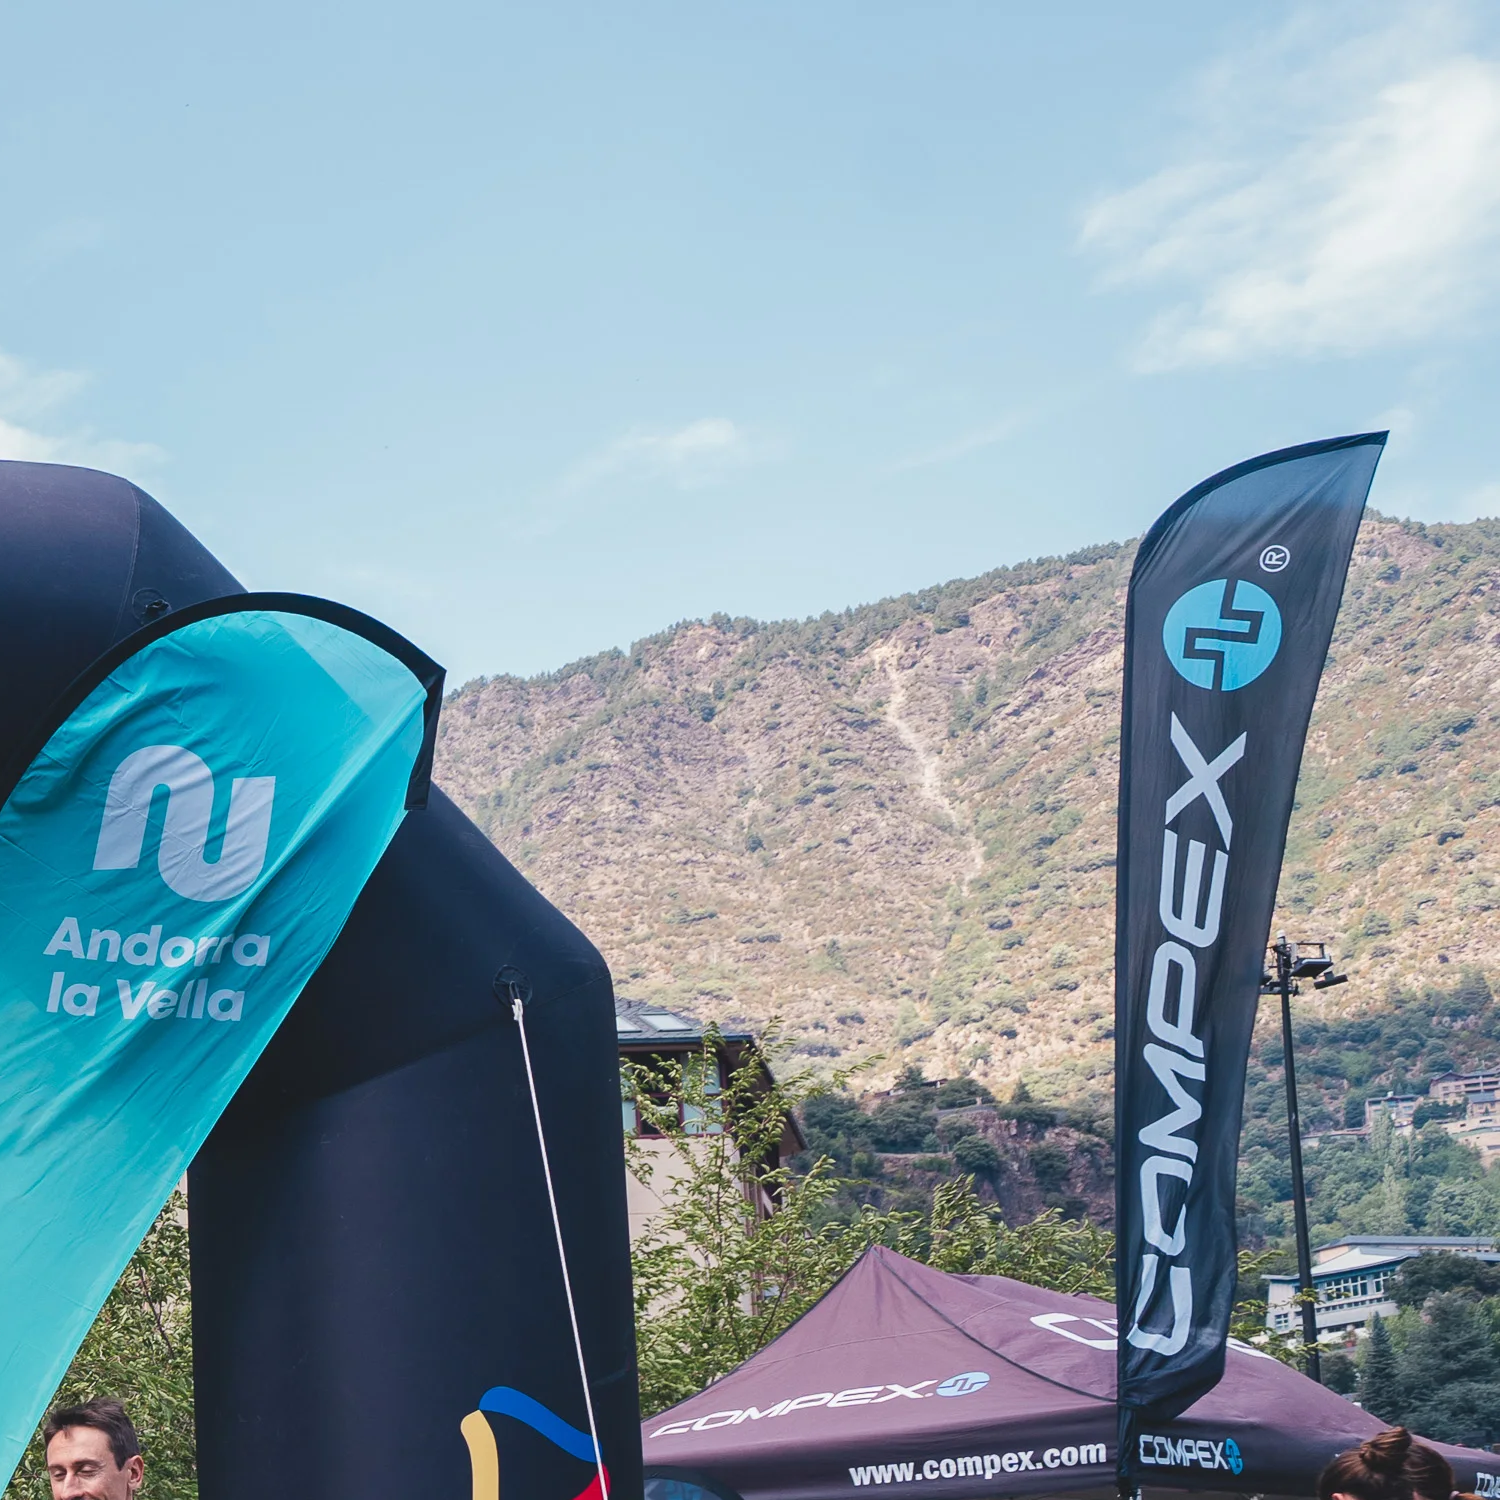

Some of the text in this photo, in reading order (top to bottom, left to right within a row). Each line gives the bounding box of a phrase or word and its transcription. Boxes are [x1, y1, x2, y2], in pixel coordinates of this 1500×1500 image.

[43, 917, 271, 969] Andorra
[46, 971, 245, 1022] la Vella
[1126, 711, 1247, 1357] COMPEX
[649, 1379, 939, 1439] COMPEX
[849, 1443, 1107, 1487] www.compex.com
[1139, 1434, 1230, 1470] COMPEX
